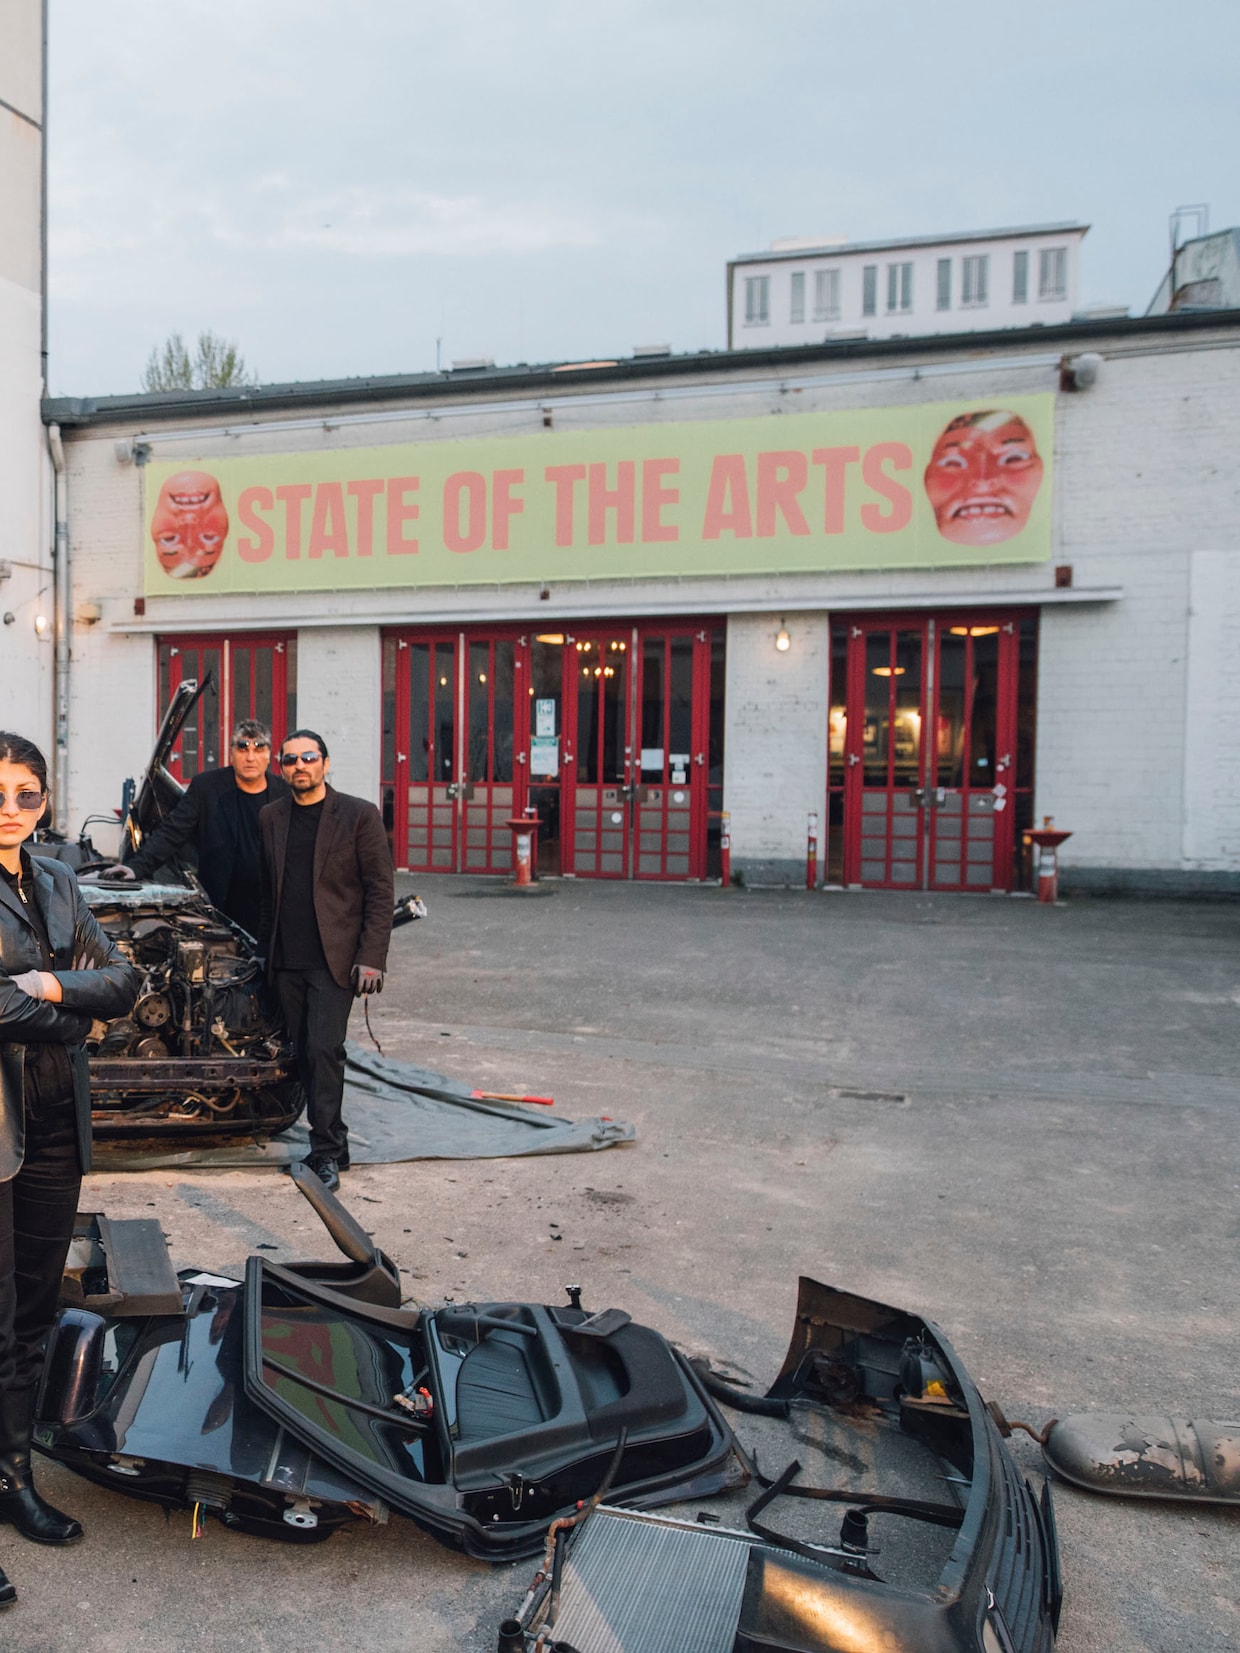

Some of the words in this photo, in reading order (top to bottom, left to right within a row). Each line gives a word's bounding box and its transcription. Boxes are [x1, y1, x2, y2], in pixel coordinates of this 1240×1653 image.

[237, 476, 420, 563] STATE
[443, 468, 524, 553] OF
[545, 458, 680, 546] THE
[702, 442, 913, 540] ARTS
